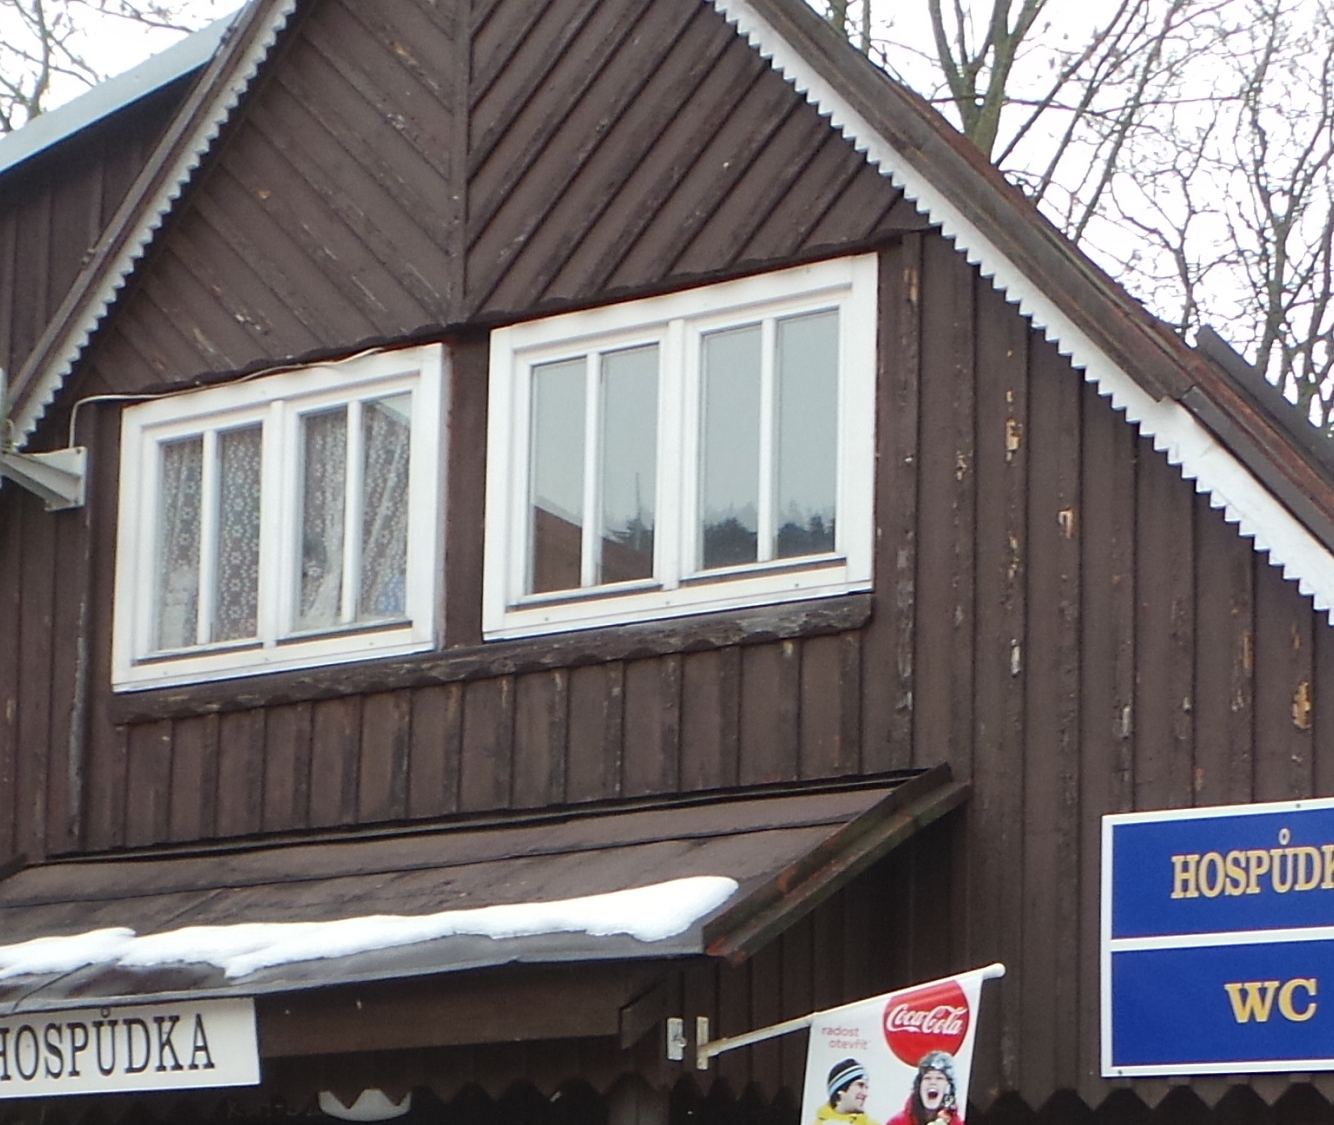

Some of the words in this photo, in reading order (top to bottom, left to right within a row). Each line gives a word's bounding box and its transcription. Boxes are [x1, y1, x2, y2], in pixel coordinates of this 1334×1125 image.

[1224, 977, 1318, 1025] WC
[821, 1026, 860, 1038] radost
[886, 1003, 969, 1036] Coca-Cola
